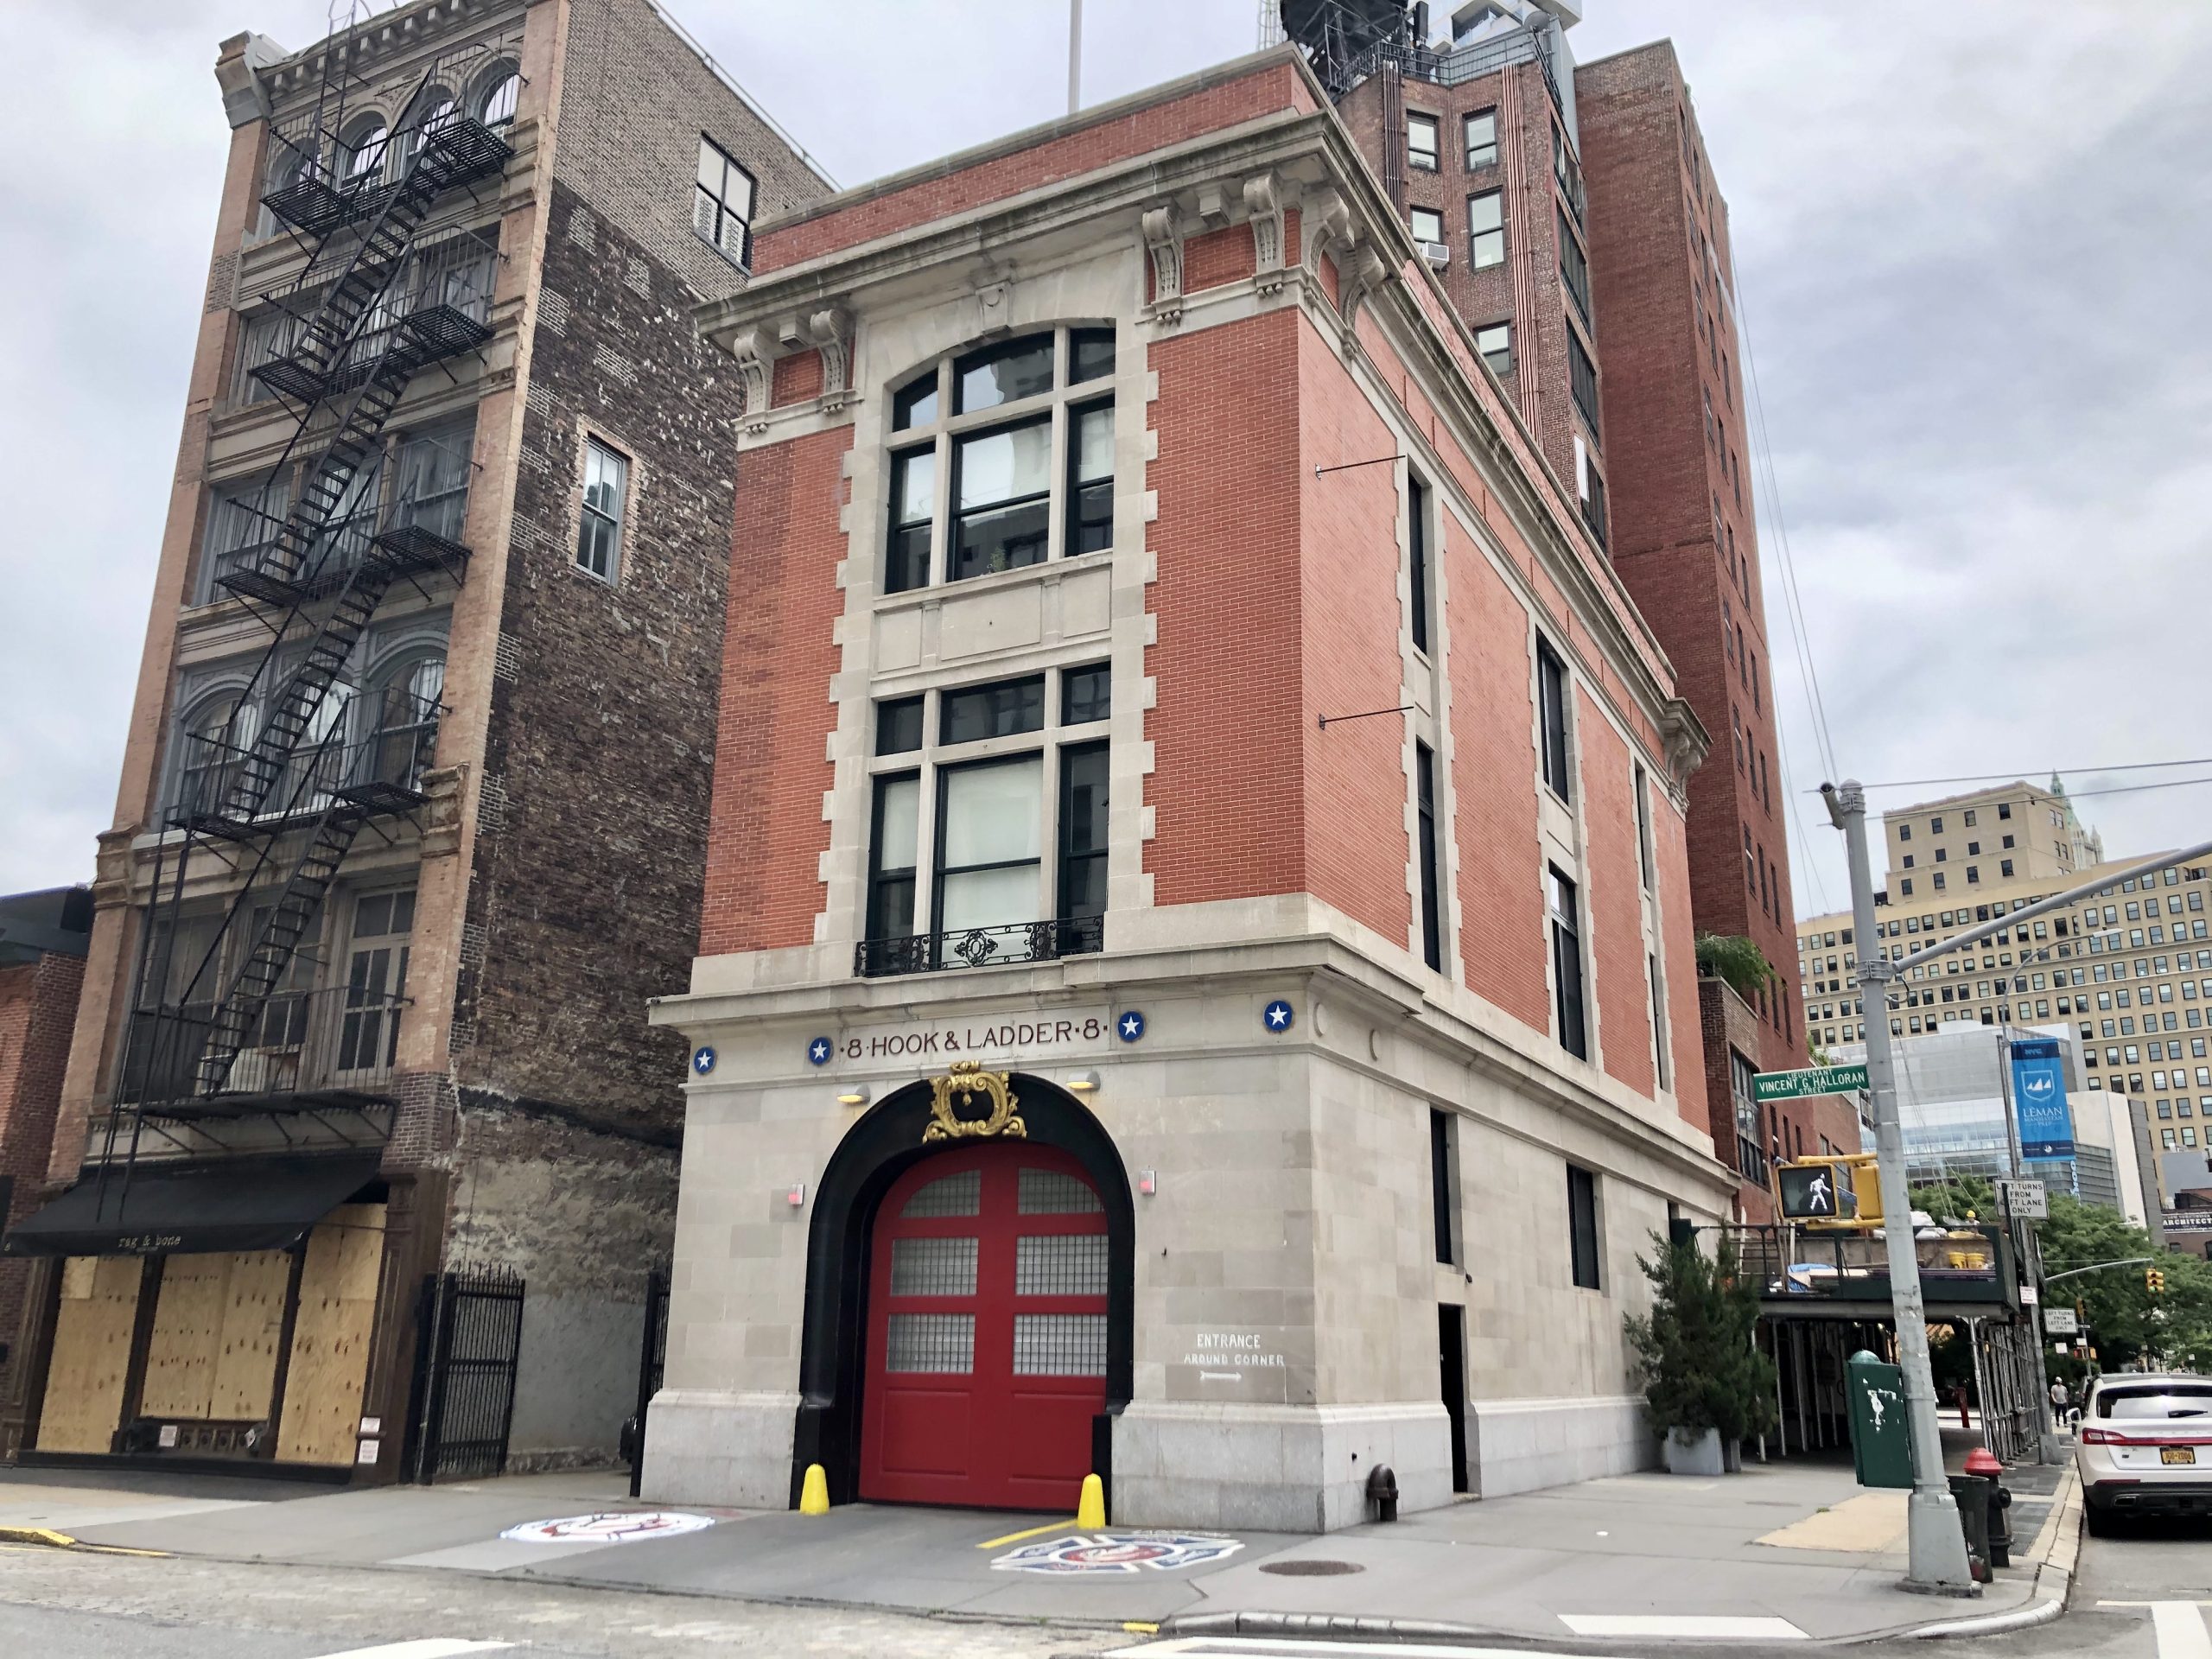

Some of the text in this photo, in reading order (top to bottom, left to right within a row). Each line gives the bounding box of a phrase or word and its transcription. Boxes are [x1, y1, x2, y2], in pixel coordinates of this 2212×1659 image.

[944, 1030, 961, 1051] &
[1759, 1071, 1865, 1092] VINCENT G HALLORAN
[1787, 1069, 1833, 1079] LIEUTENANT
[118, 1234, 181, 1249] rag & bone
[1197, 1333, 1261, 1349] ENTRANCE
[1183, 1353, 1285, 1367] AROUND CORNER
